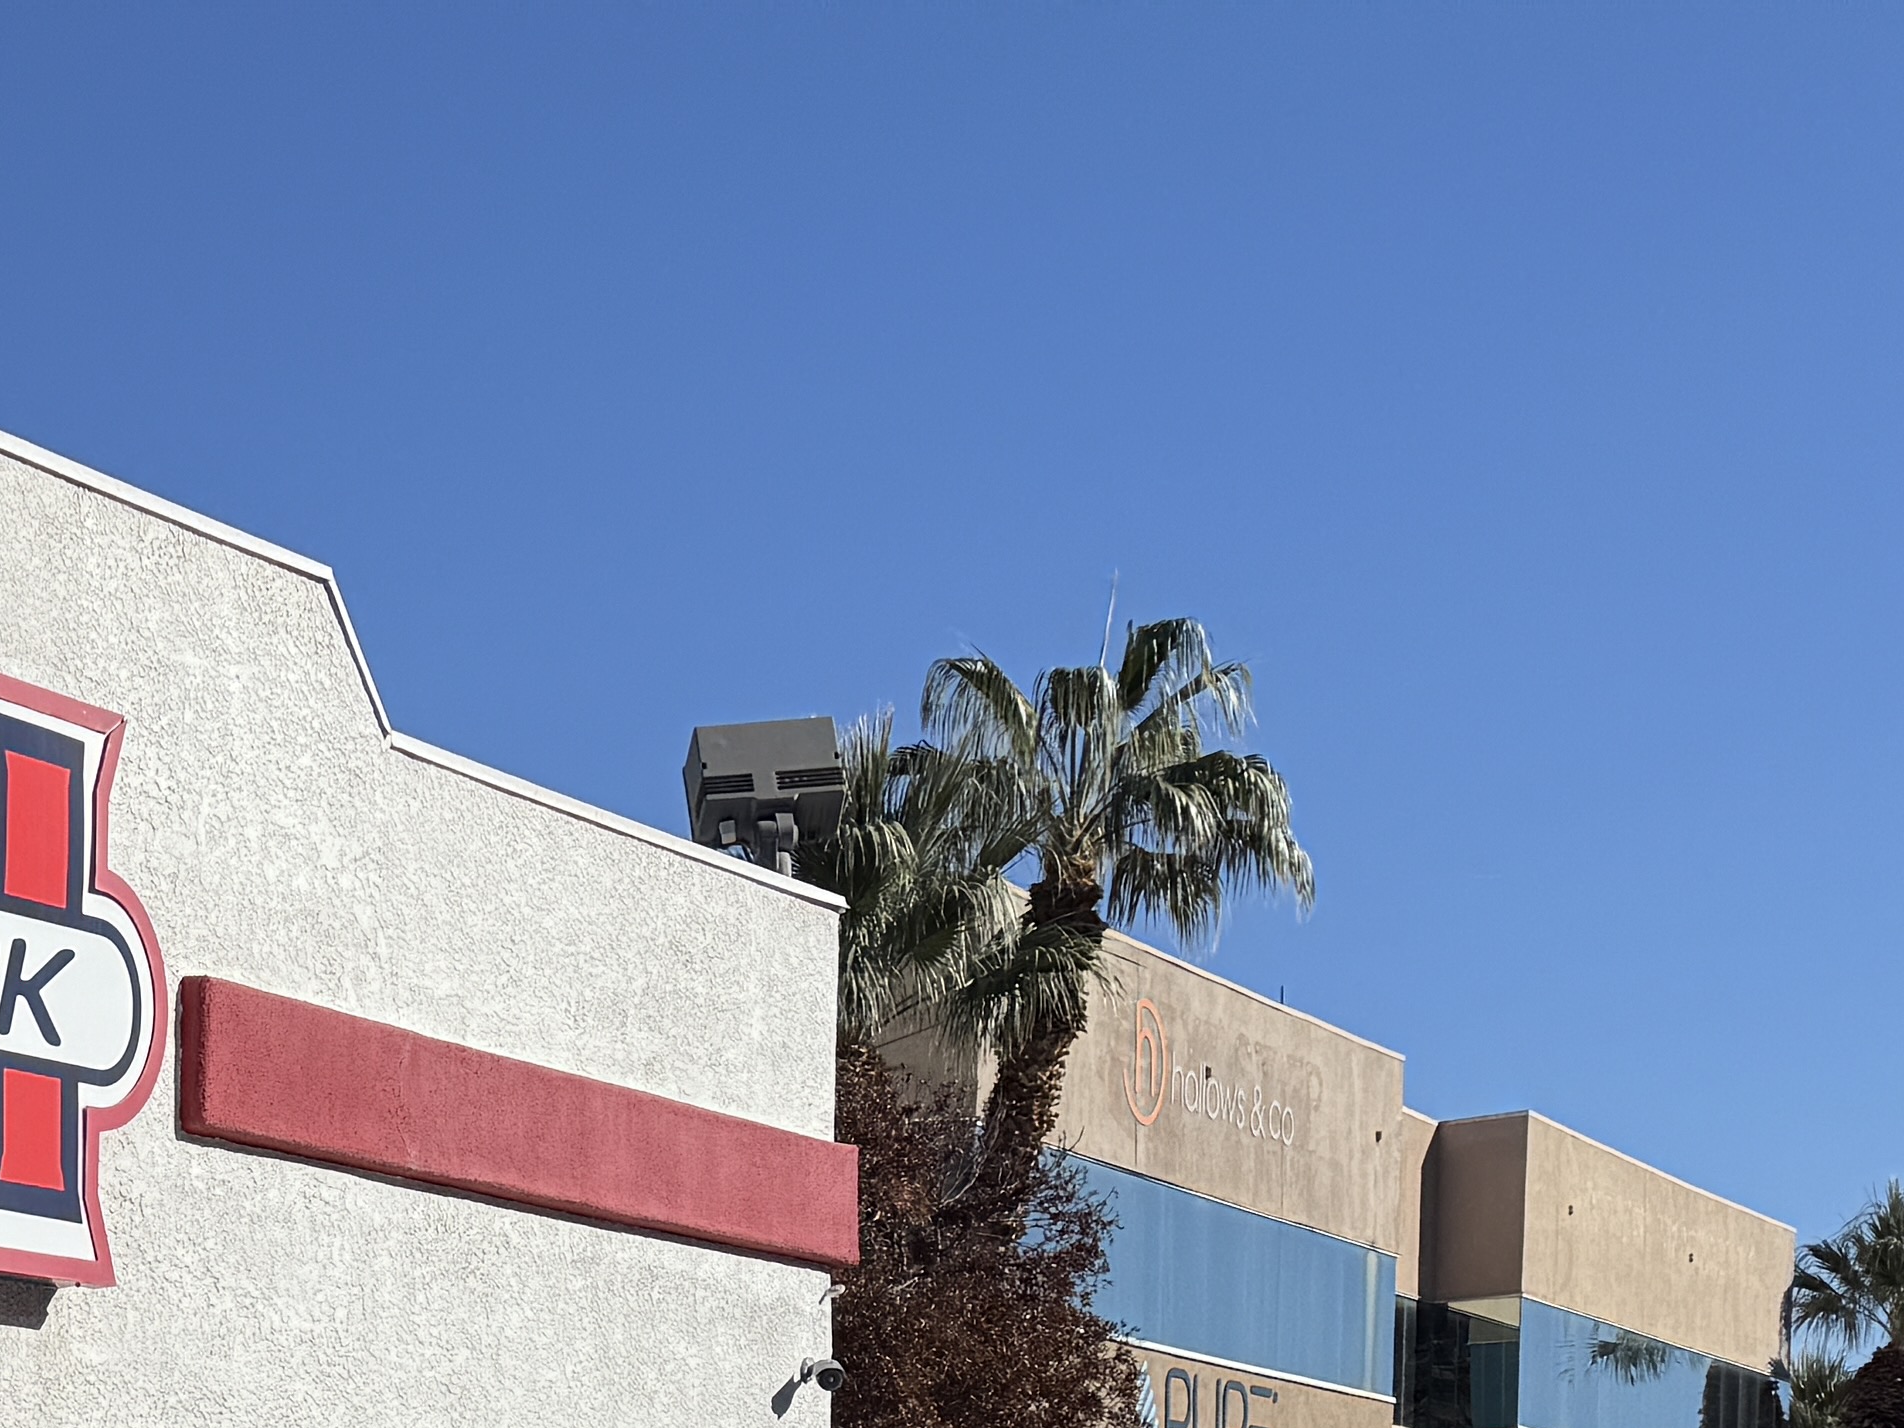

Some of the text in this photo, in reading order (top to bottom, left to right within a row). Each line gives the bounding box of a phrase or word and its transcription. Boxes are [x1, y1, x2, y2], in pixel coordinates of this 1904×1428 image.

[1171, 1051, 1295, 1146] hallows & co
